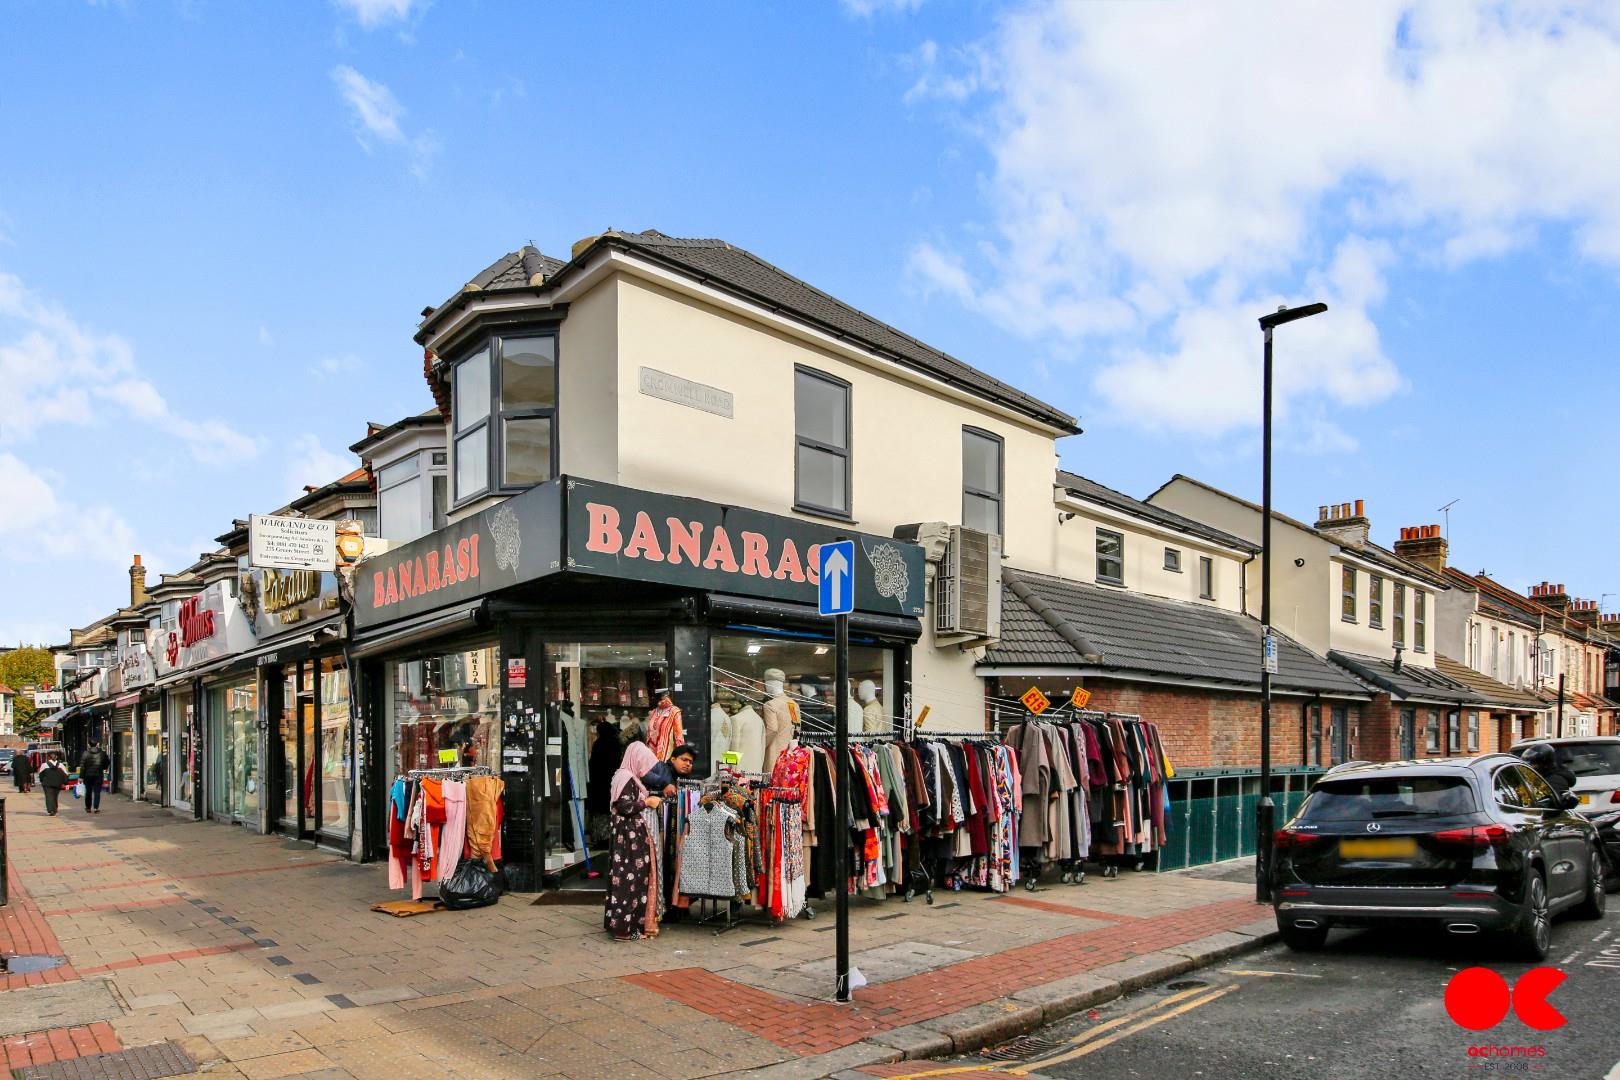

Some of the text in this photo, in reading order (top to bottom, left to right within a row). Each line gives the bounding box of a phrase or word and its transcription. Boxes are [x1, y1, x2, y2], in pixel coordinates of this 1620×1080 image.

[260, 518, 306, 530] MARKAND
[316, 524, 329, 532] CO
[280, 528, 308, 536] Solicitors
[585, 502, 820, 586] BANARAS
[373, 533, 480, 609] BANARASI
[1025, 692, 1045, 712] £15
